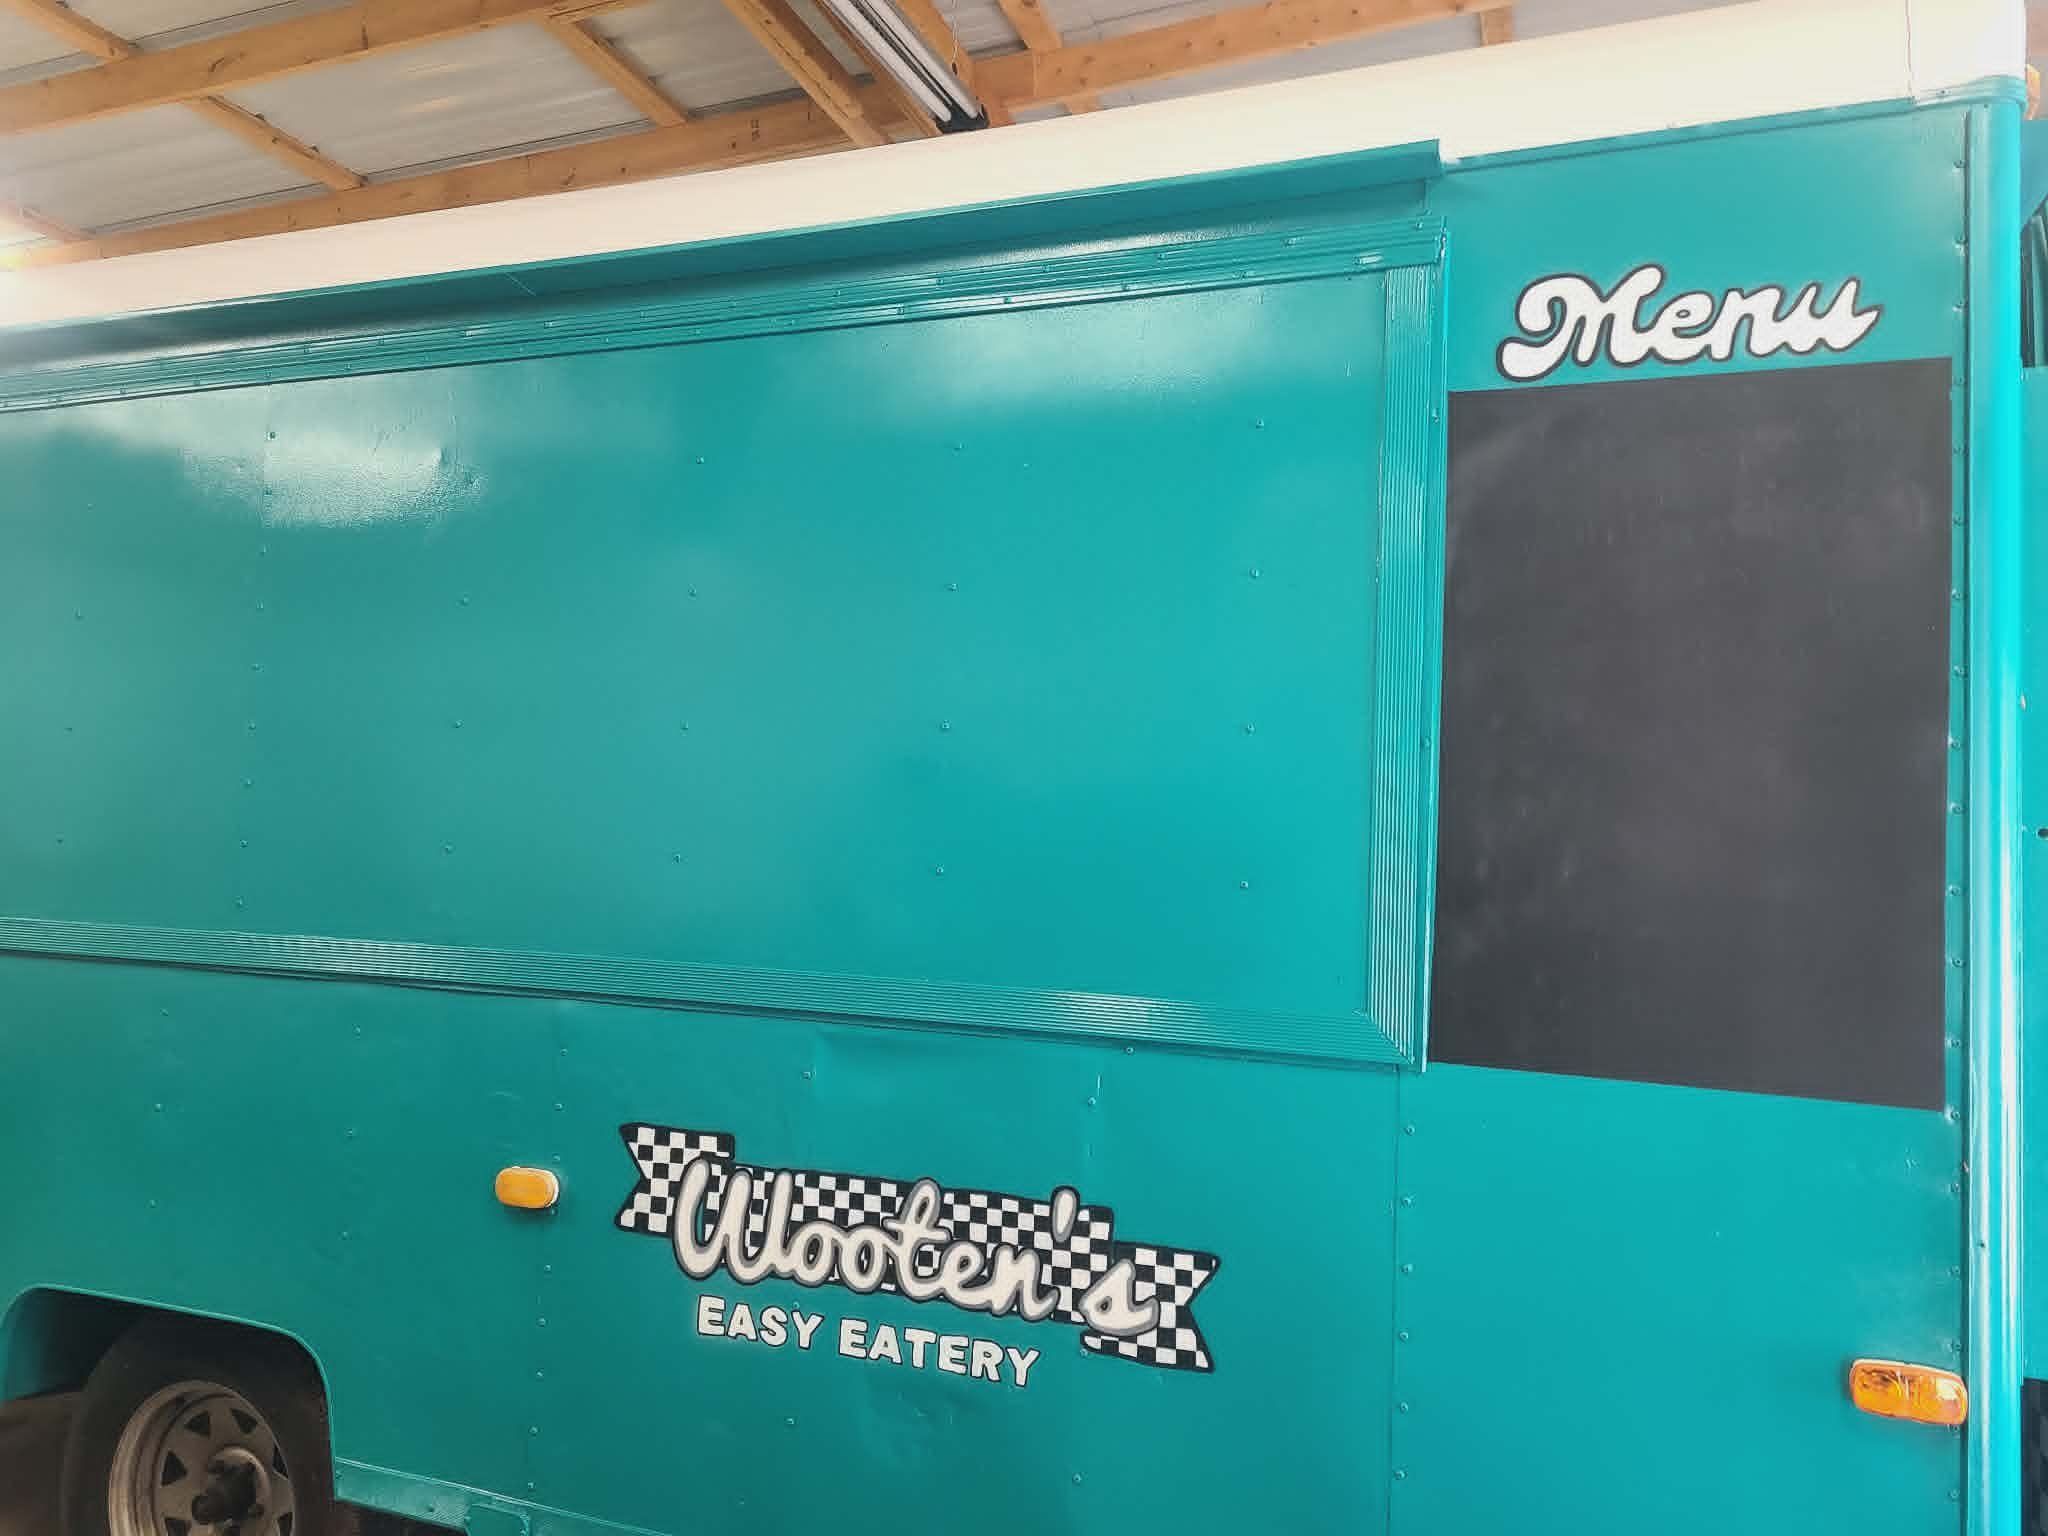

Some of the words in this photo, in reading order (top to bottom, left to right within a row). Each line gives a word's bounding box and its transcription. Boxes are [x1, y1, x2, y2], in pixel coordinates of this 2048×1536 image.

[1497, 263, 1884, 381] Menu
[672, 1157, 1160, 1334] Wooten's
[697, 1295, 823, 1349] EASY
[838, 1318, 1040, 1387] EATERY
